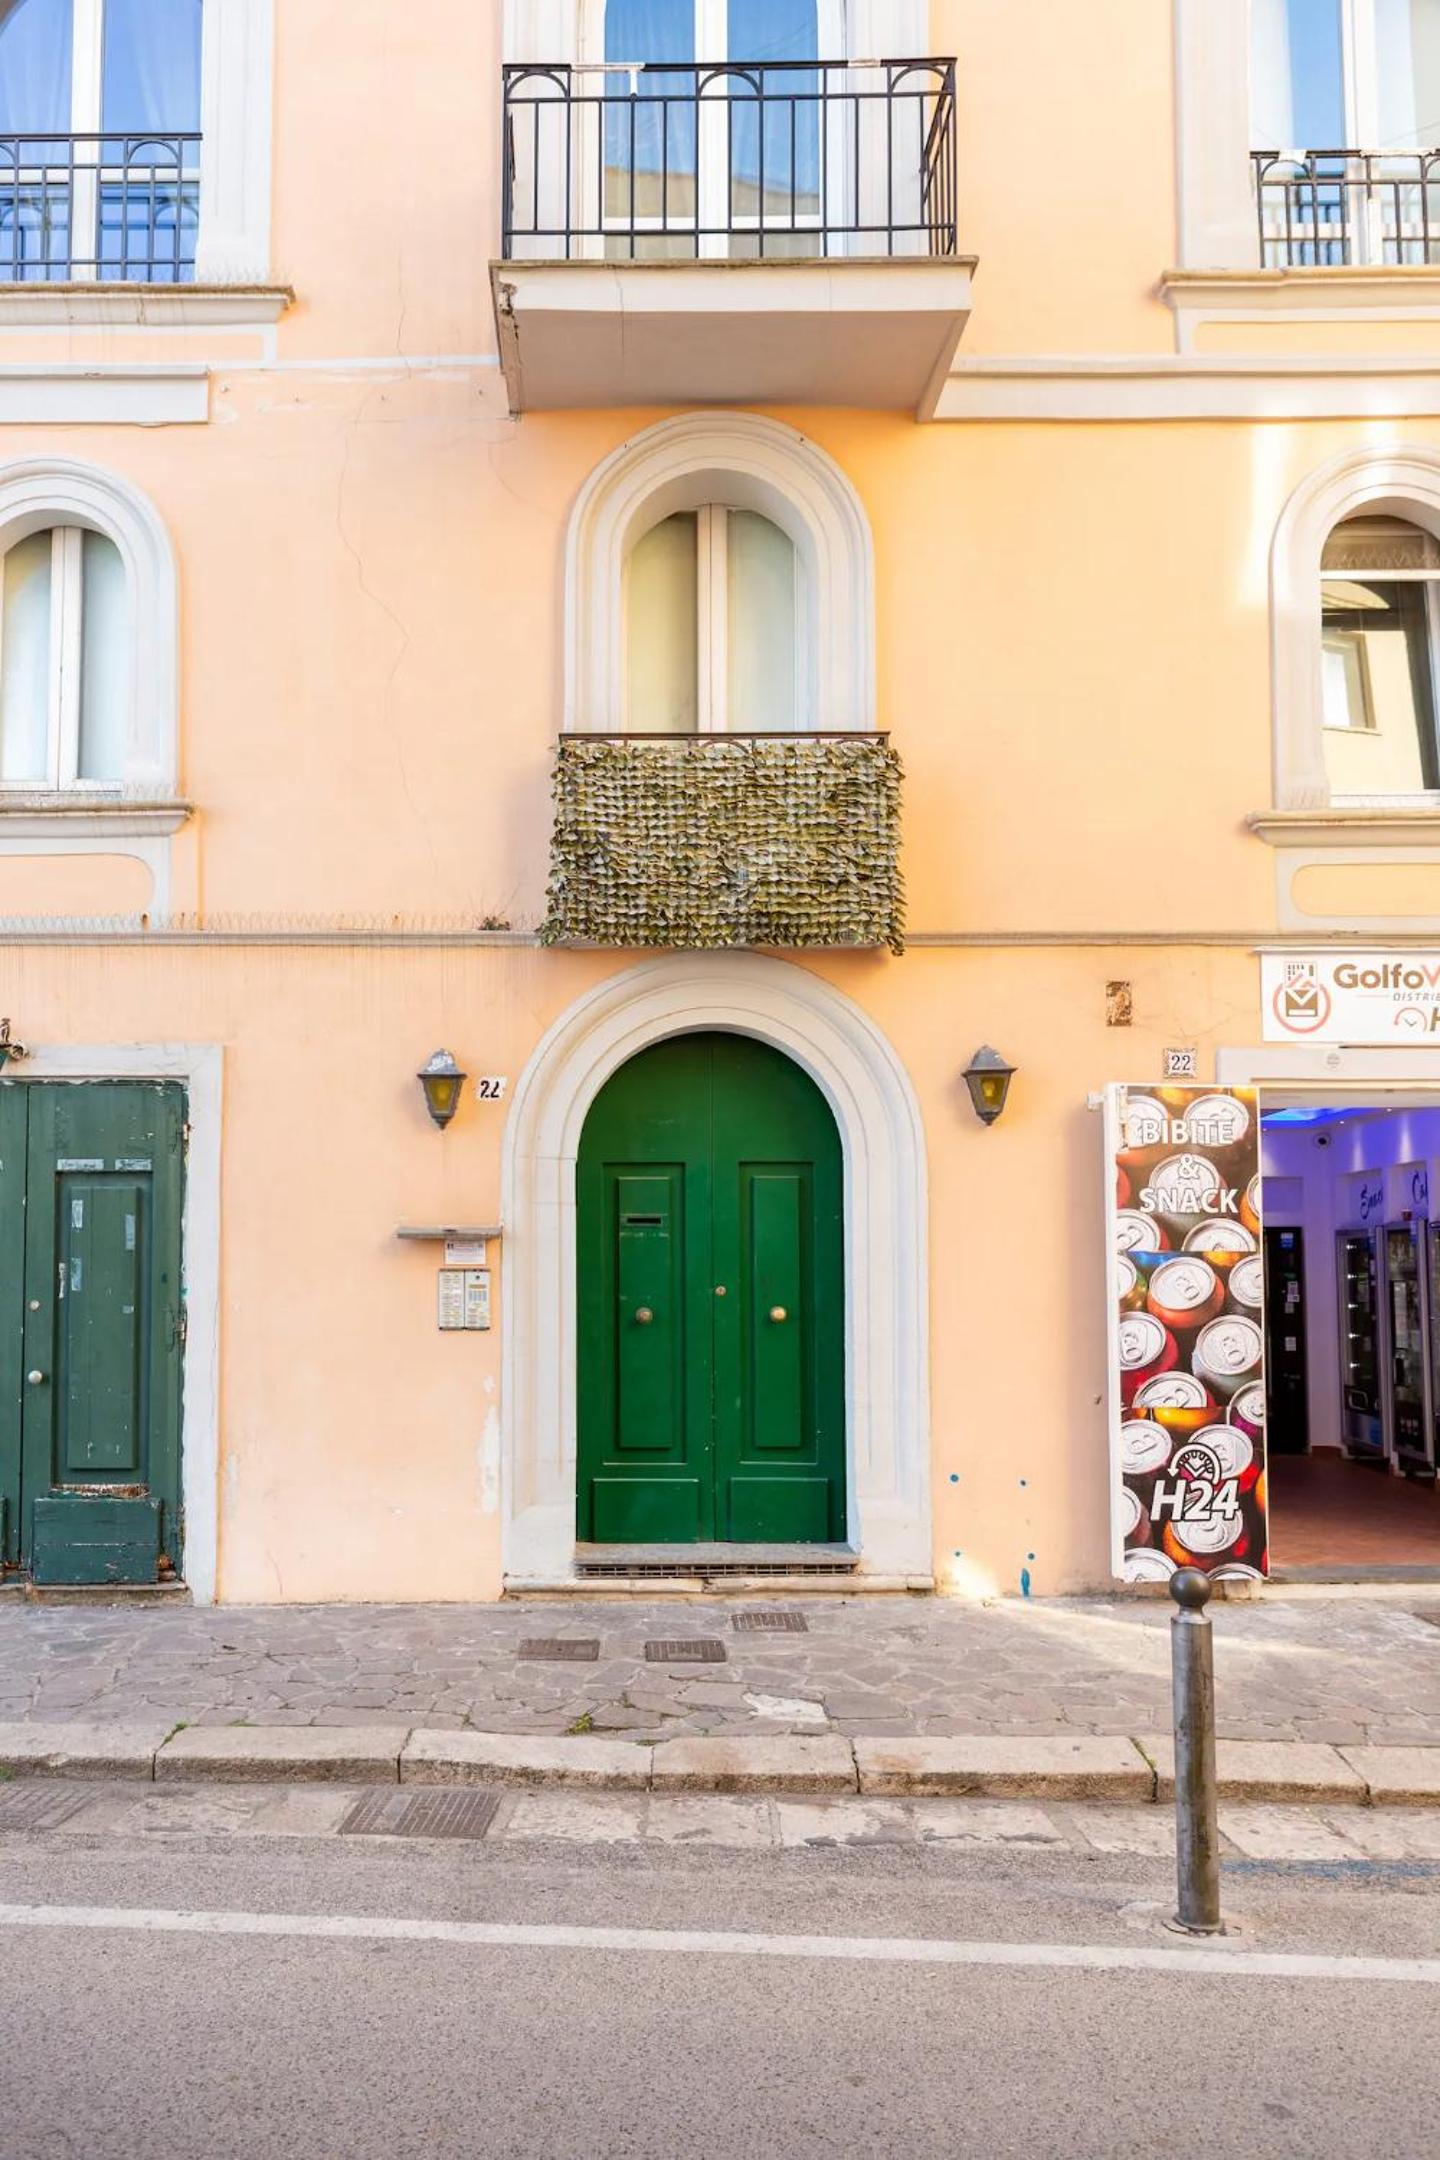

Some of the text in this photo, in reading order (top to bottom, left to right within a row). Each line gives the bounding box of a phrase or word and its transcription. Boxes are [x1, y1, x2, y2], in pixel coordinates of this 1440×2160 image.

[1171, 1054, 1191, 1071] 22
[1141, 1118, 1235, 1145] BIBITE
[1178, 1153, 1200, 1180] &
[1138, 1187, 1240, 1214] SNACK
[1150, 1479, 1240, 1521] H24
